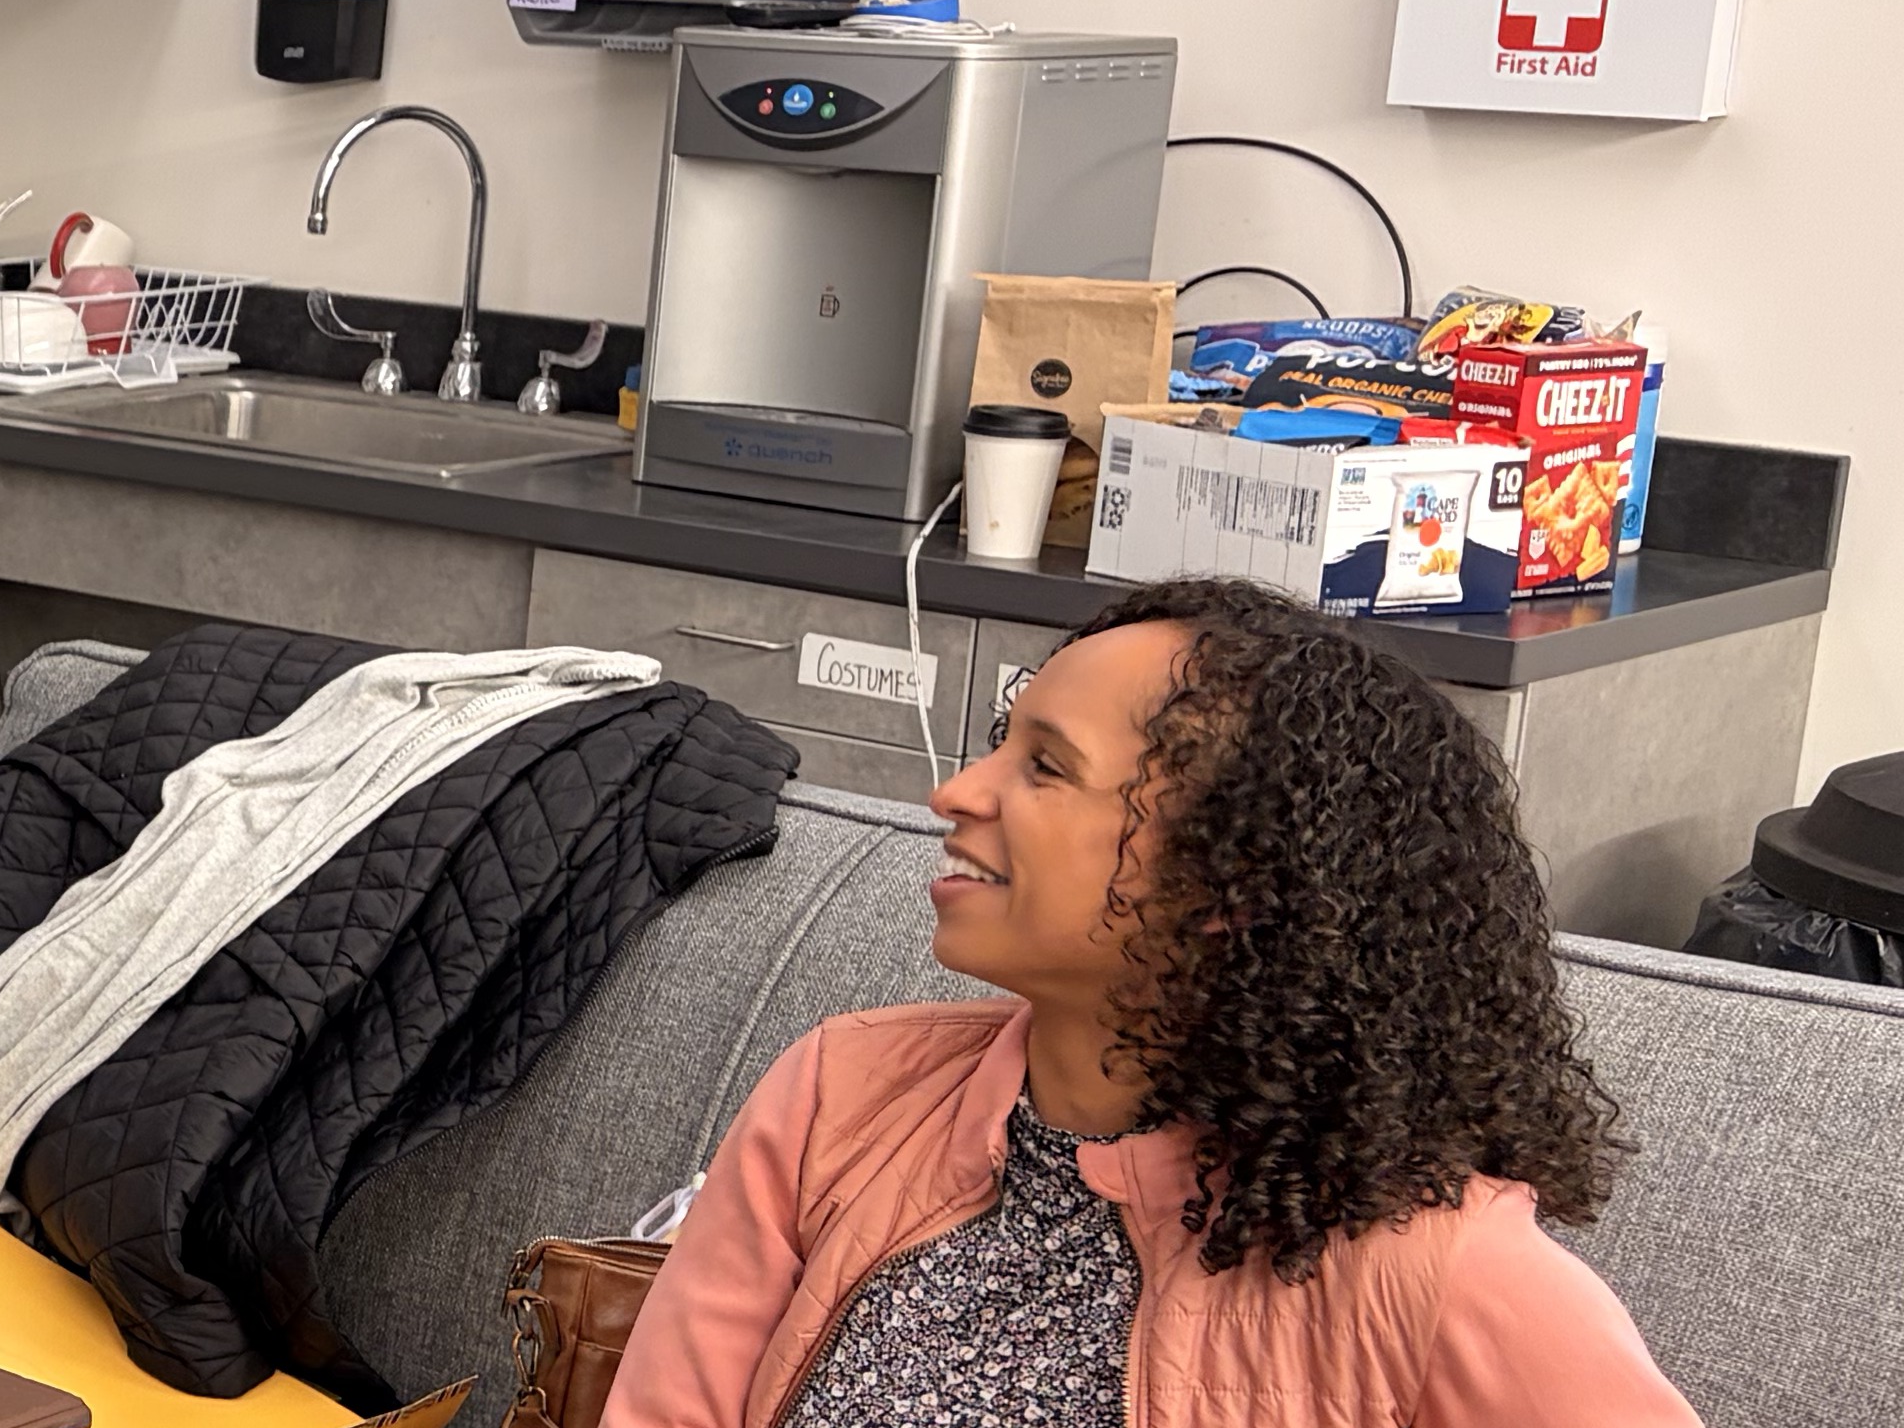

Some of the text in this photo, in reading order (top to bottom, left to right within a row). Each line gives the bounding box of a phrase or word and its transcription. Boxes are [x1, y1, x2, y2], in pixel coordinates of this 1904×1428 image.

[1496, 53, 1598, 77] First Aid
[1328, 375, 1412, 398] ORGANIC
[1544, 443, 1602, 469] ORIGINAL
[1495, 467, 1523, 493] 10
[817, 641, 922, 702] COSTUMES
